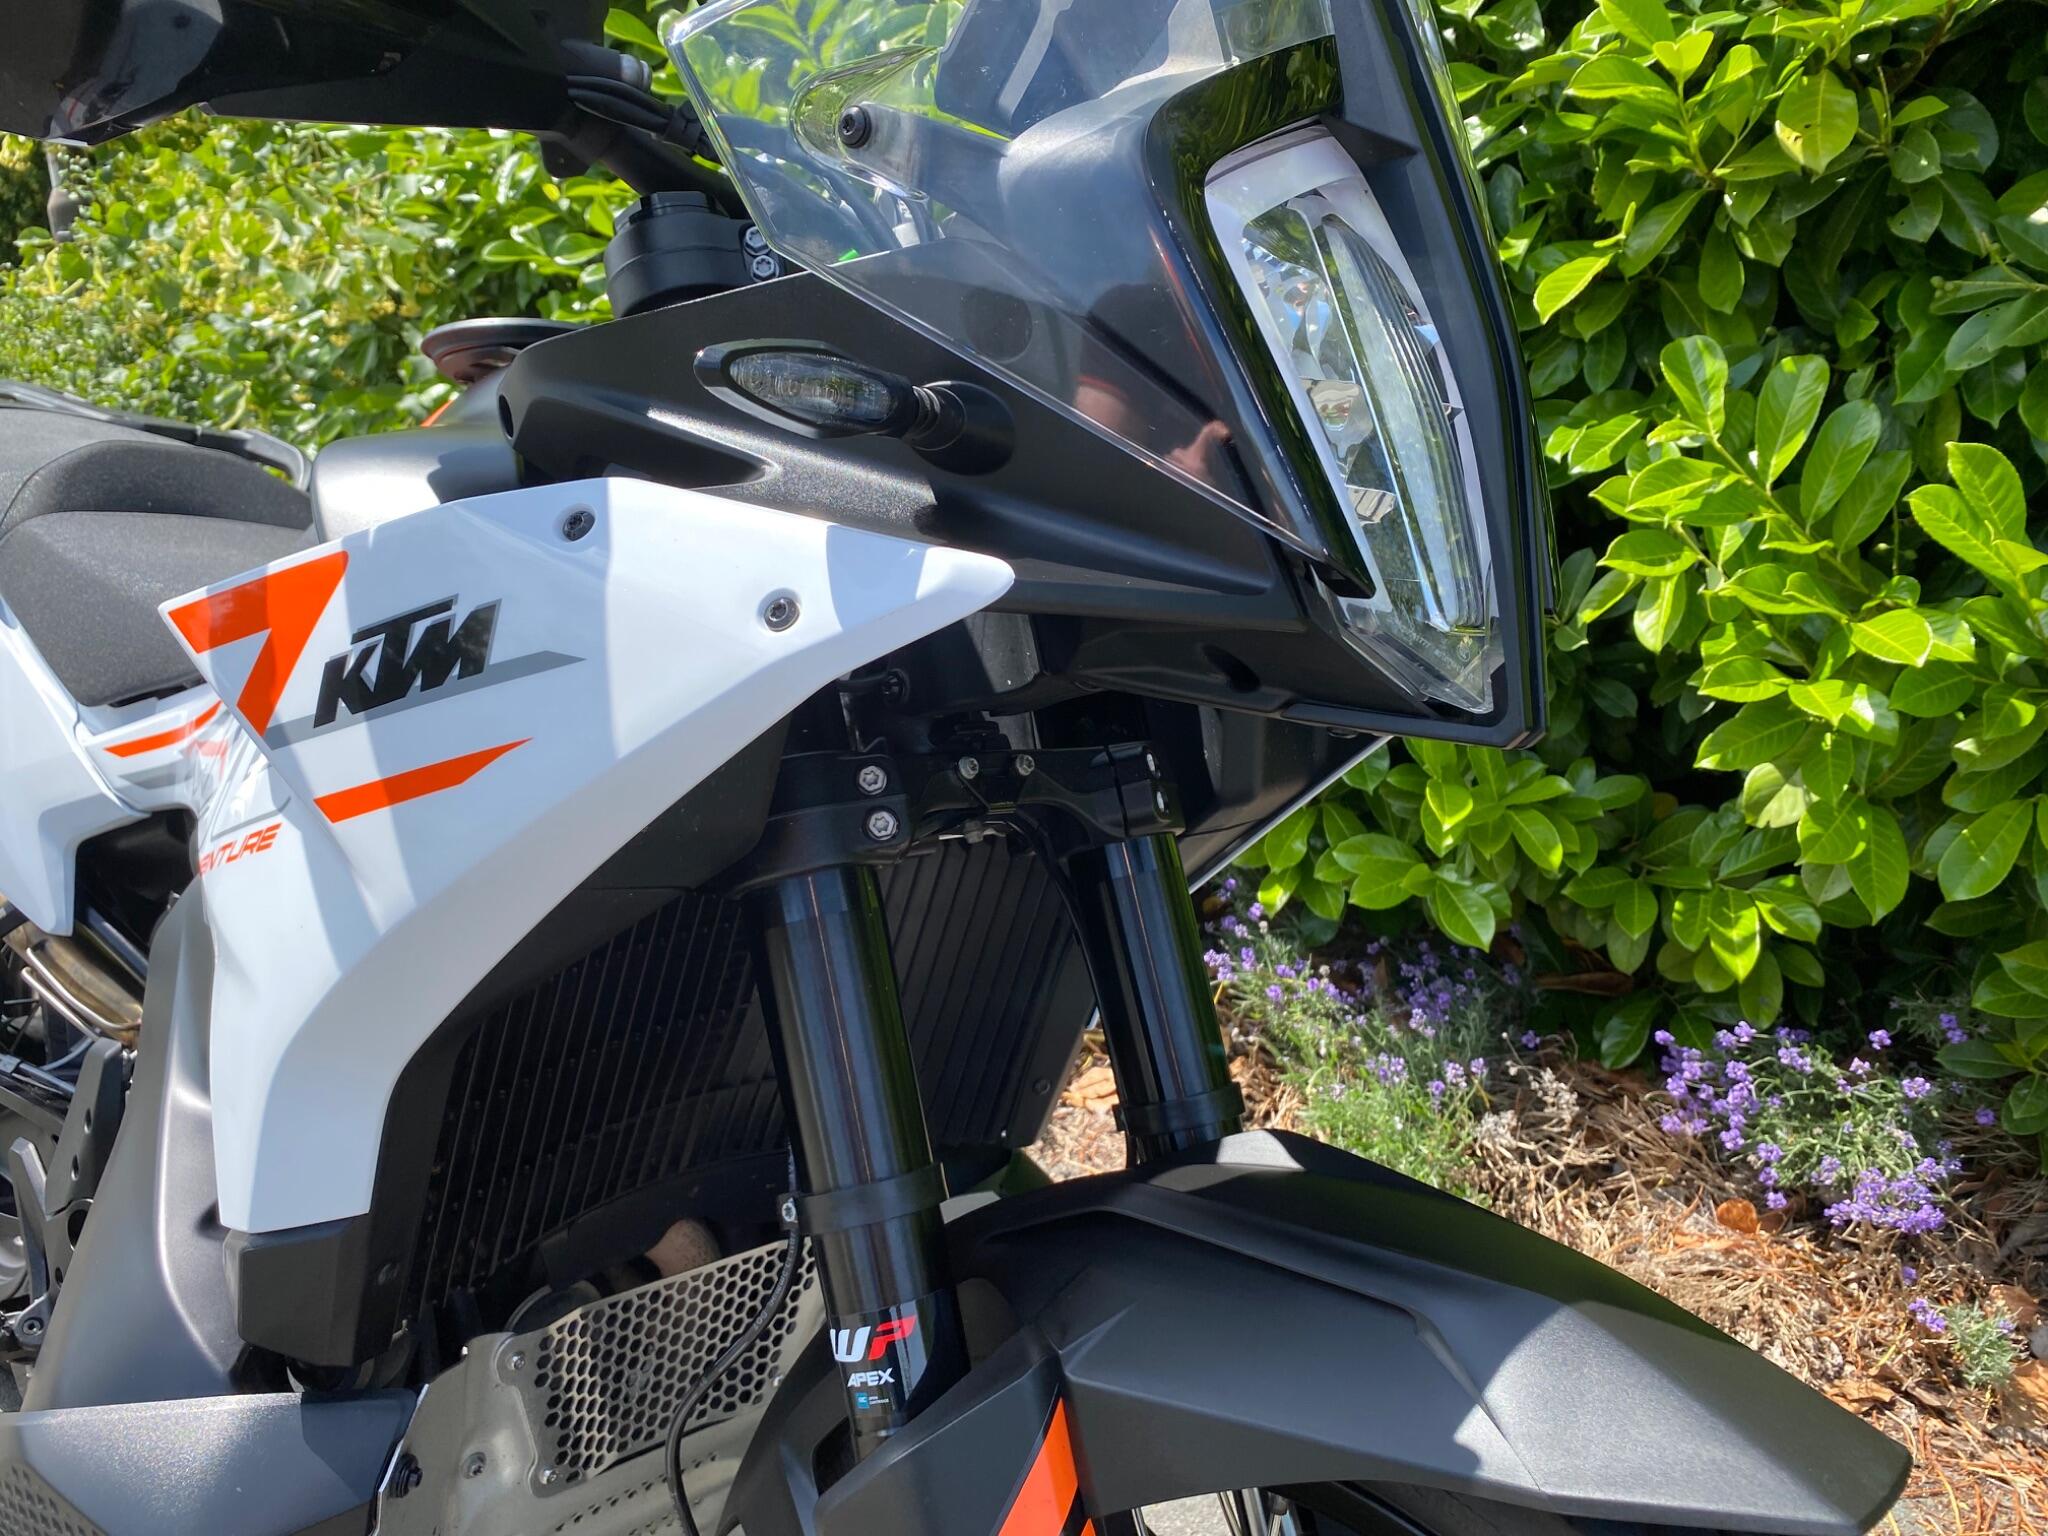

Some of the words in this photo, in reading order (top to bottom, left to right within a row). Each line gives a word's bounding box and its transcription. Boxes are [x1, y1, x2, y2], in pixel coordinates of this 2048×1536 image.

[314, 594, 501, 728] KTM
[830, 1315, 917, 1363] WP
[847, 1368, 895, 1388] APEX
